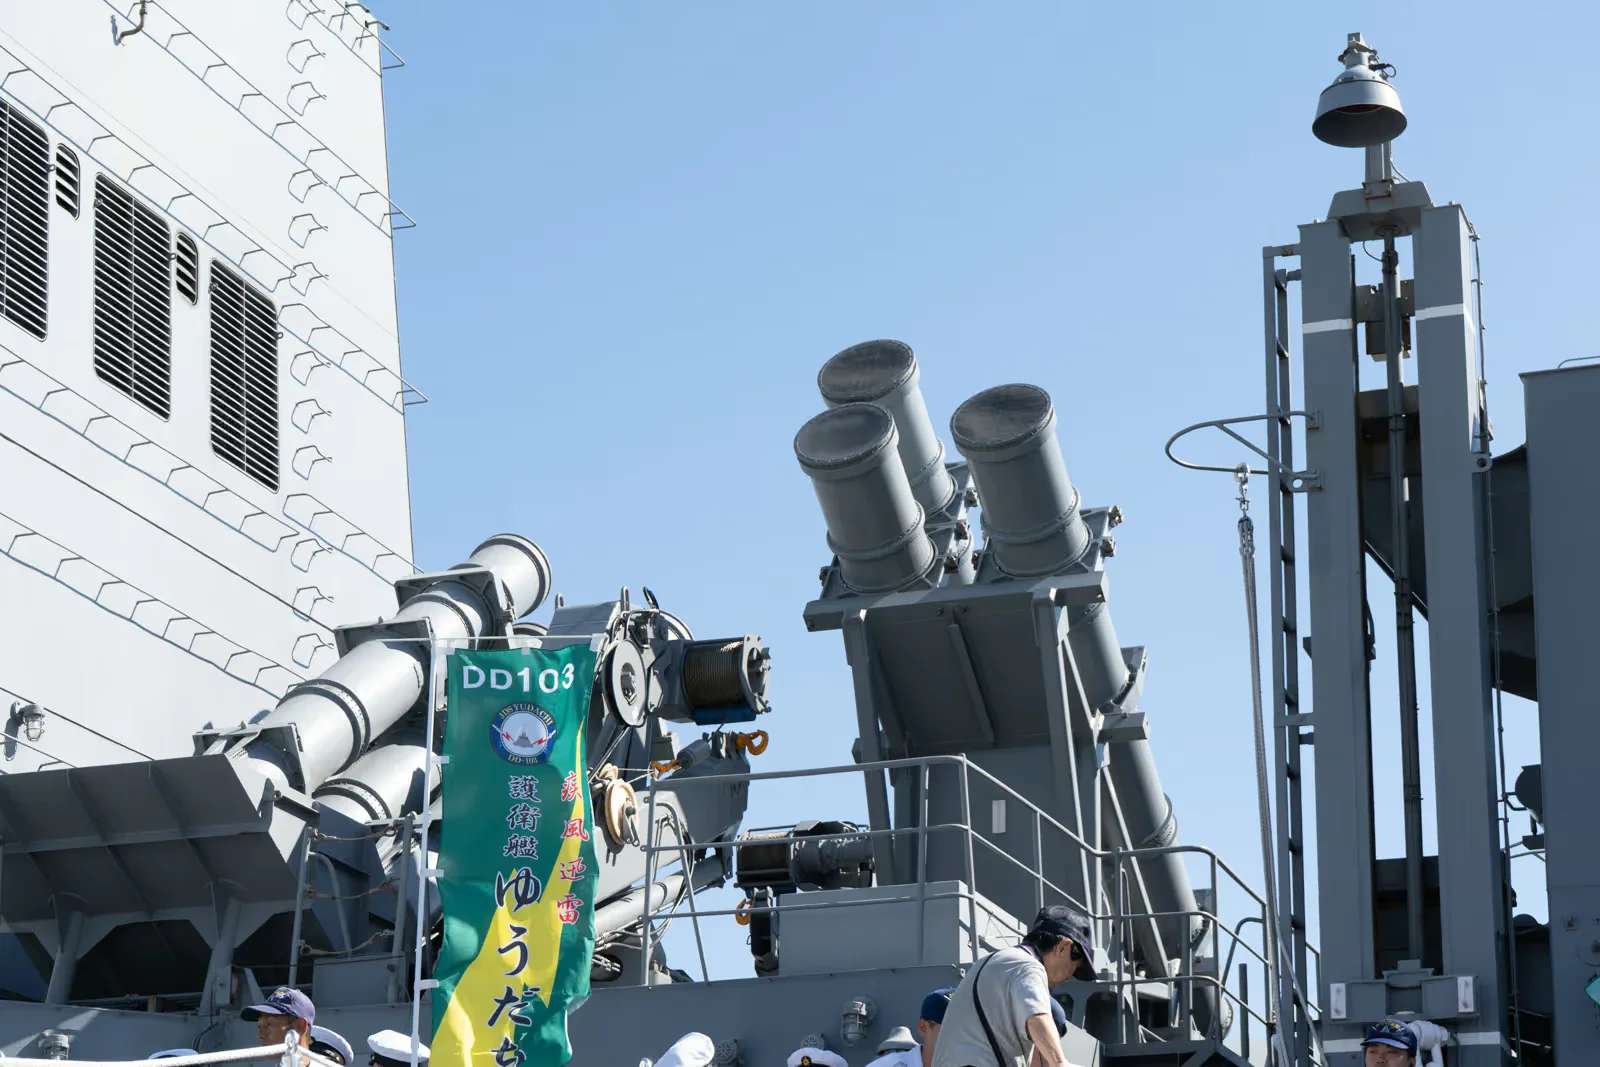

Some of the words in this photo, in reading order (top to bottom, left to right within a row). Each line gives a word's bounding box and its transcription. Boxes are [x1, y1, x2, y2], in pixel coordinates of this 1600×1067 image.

[463, 663, 575, 693] DD103
[513, 703, 553, 726] YUDACHI
[507, 754, 538, 764] DD-103
[557, 771, 589, 924] 疾風迅雷
